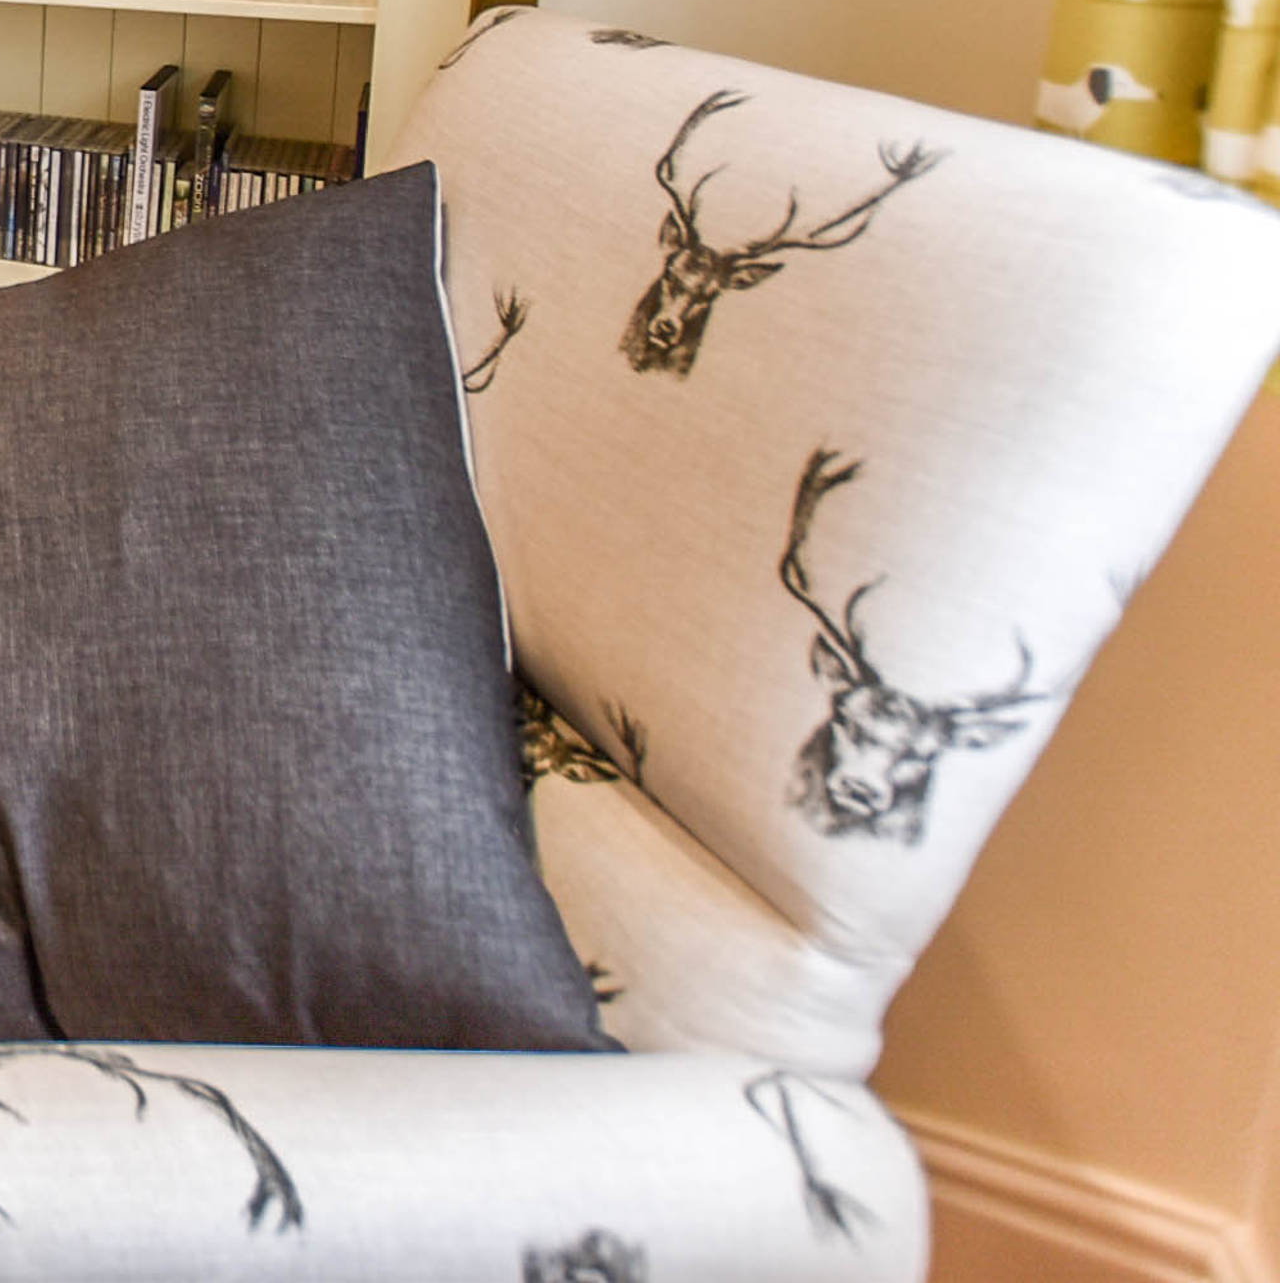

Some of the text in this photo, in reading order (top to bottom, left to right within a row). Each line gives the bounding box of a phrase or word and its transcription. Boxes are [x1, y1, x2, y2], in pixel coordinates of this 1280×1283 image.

[141, 100, 153, 131] Electric
[139, 132, 152, 154] Light
[137, 155, 150, 195] Orchestra
